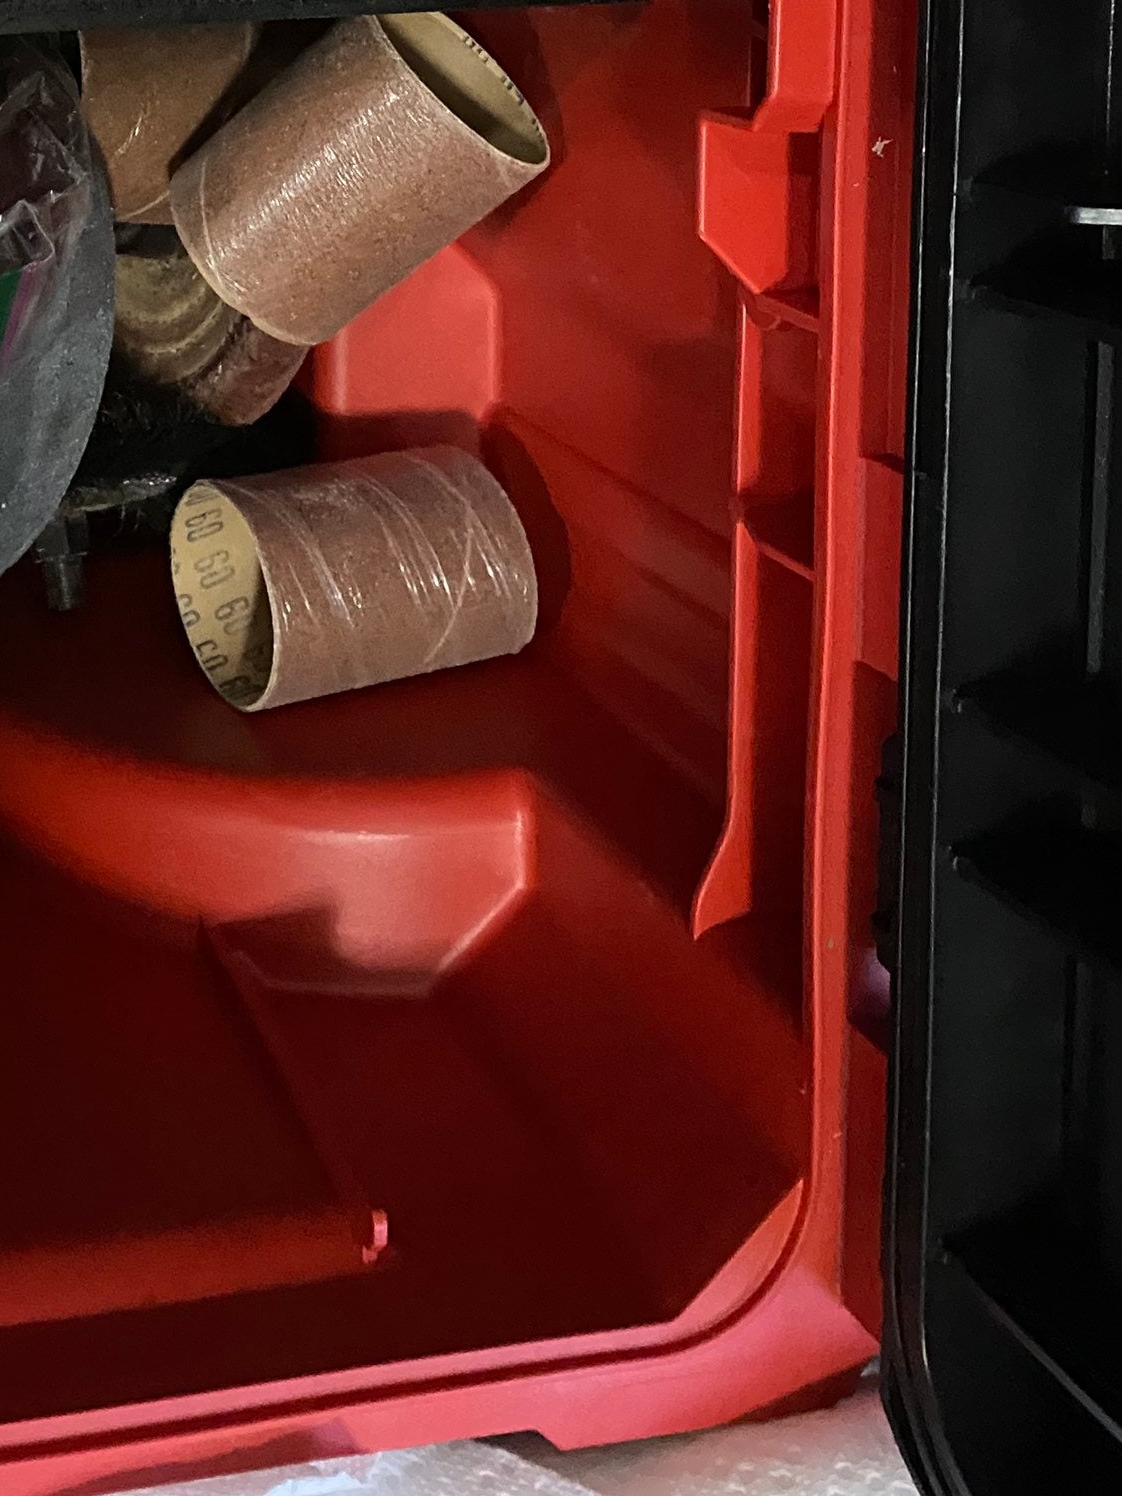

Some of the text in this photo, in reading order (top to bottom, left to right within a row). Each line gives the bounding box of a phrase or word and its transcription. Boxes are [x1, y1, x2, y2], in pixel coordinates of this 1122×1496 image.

[184, 507, 224, 543] 60
[194, 549, 235, 590] 60
[215, 595, 250, 636] 60
